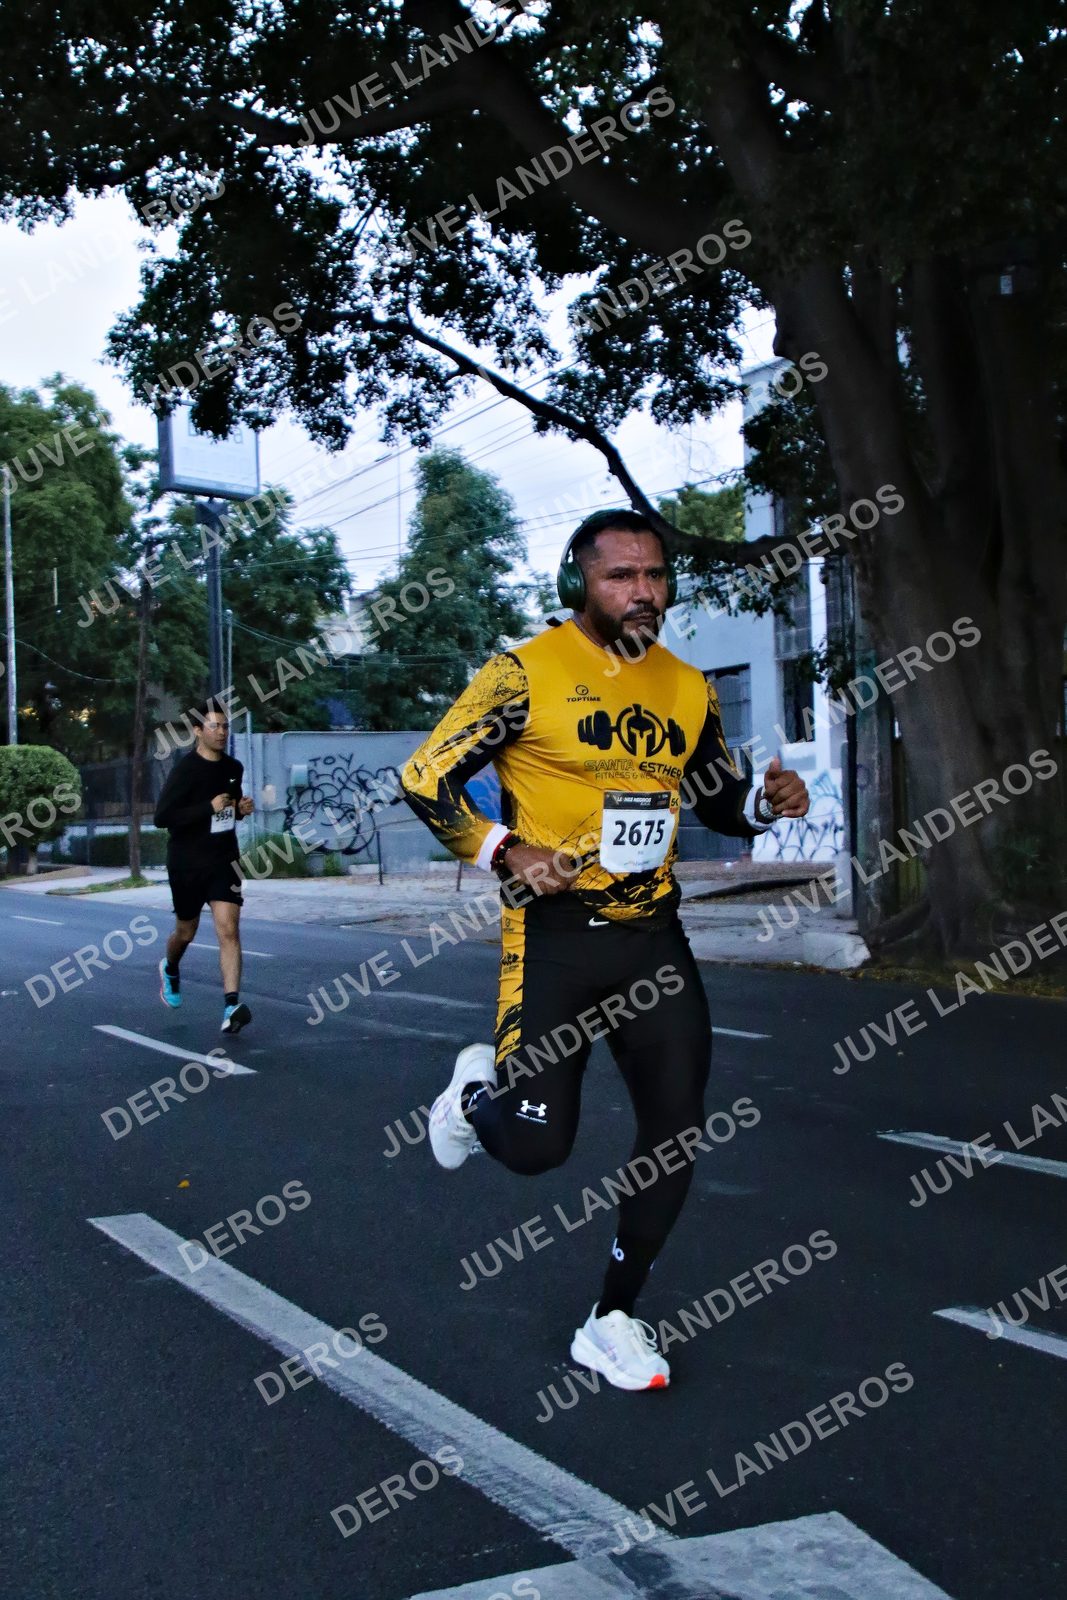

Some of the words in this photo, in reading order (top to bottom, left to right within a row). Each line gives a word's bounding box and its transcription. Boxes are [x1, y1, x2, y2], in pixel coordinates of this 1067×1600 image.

[584, 758, 635, 772] SANTA
[639, 761, 682, 779] ESTHER
[595, 771, 631, 780] FITNESS
[613, 819, 666, 846] 2675
